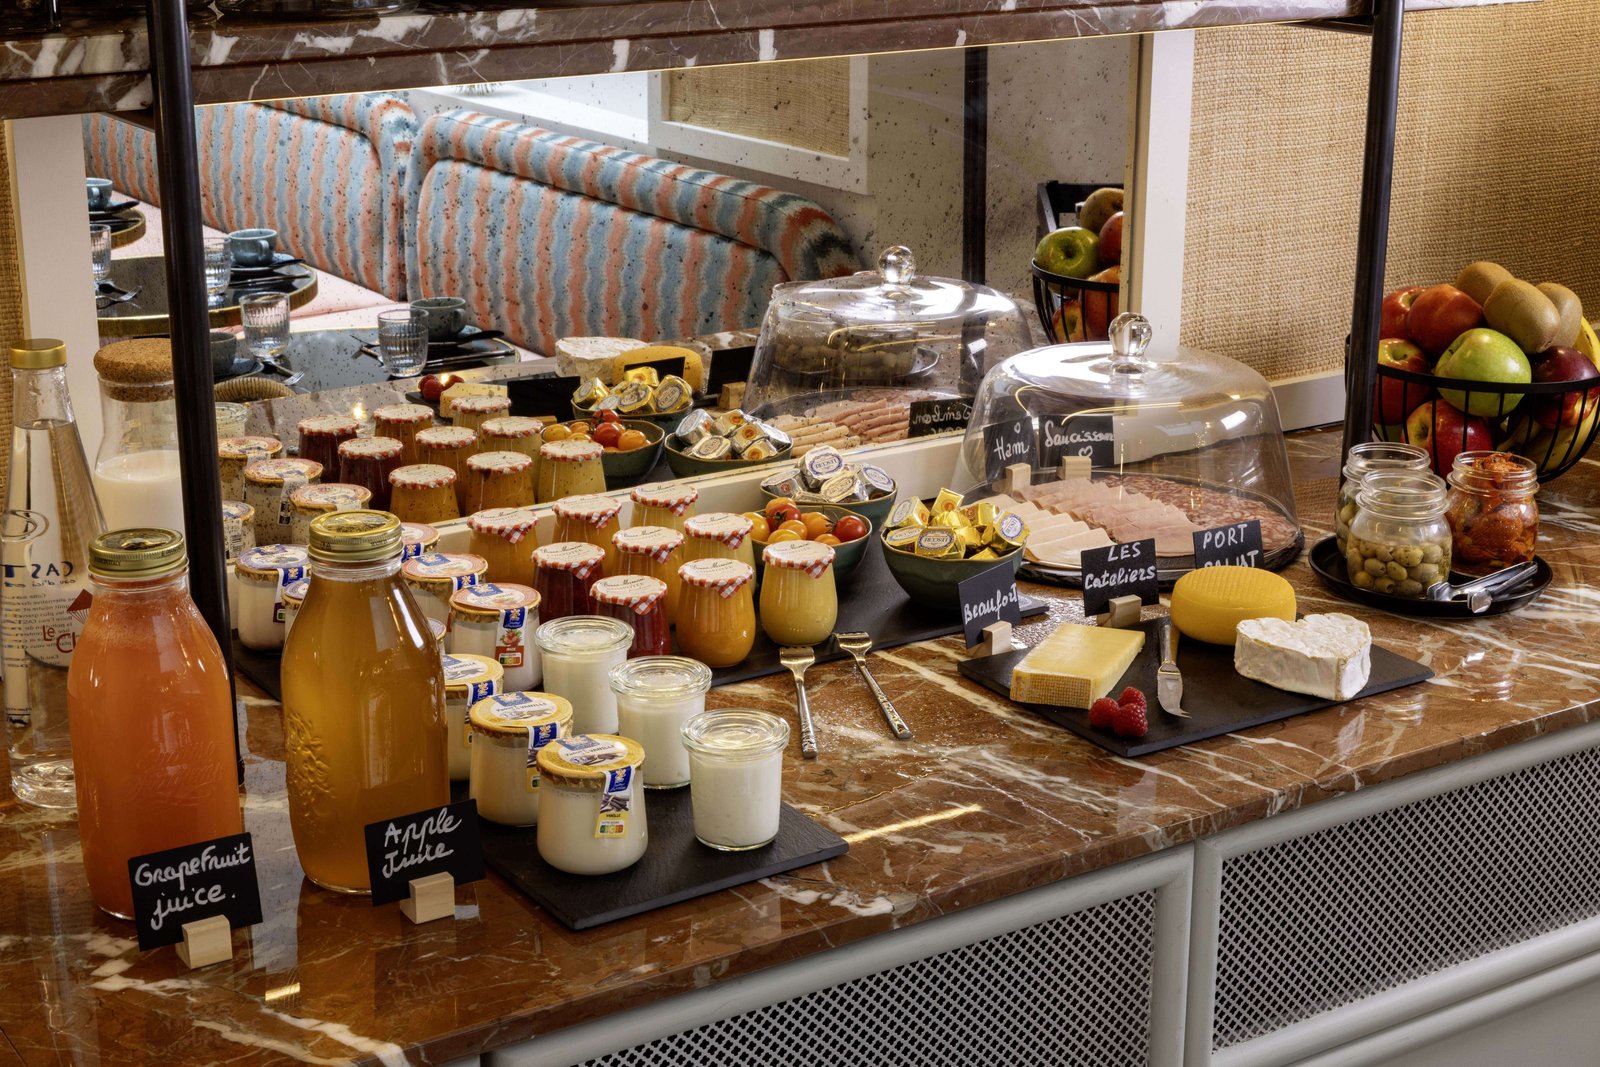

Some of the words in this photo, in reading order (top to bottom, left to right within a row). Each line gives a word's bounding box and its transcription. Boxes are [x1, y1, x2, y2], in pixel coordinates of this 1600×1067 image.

[993, 435, 1030, 461] Ham
[1107, 541, 1142, 562] LES
[1203, 523, 1248, 549] PORT
[964, 582, 1018, 625] Beaufort
[384, 806, 463, 855] Apple
[382, 842, 454, 879] Juice
